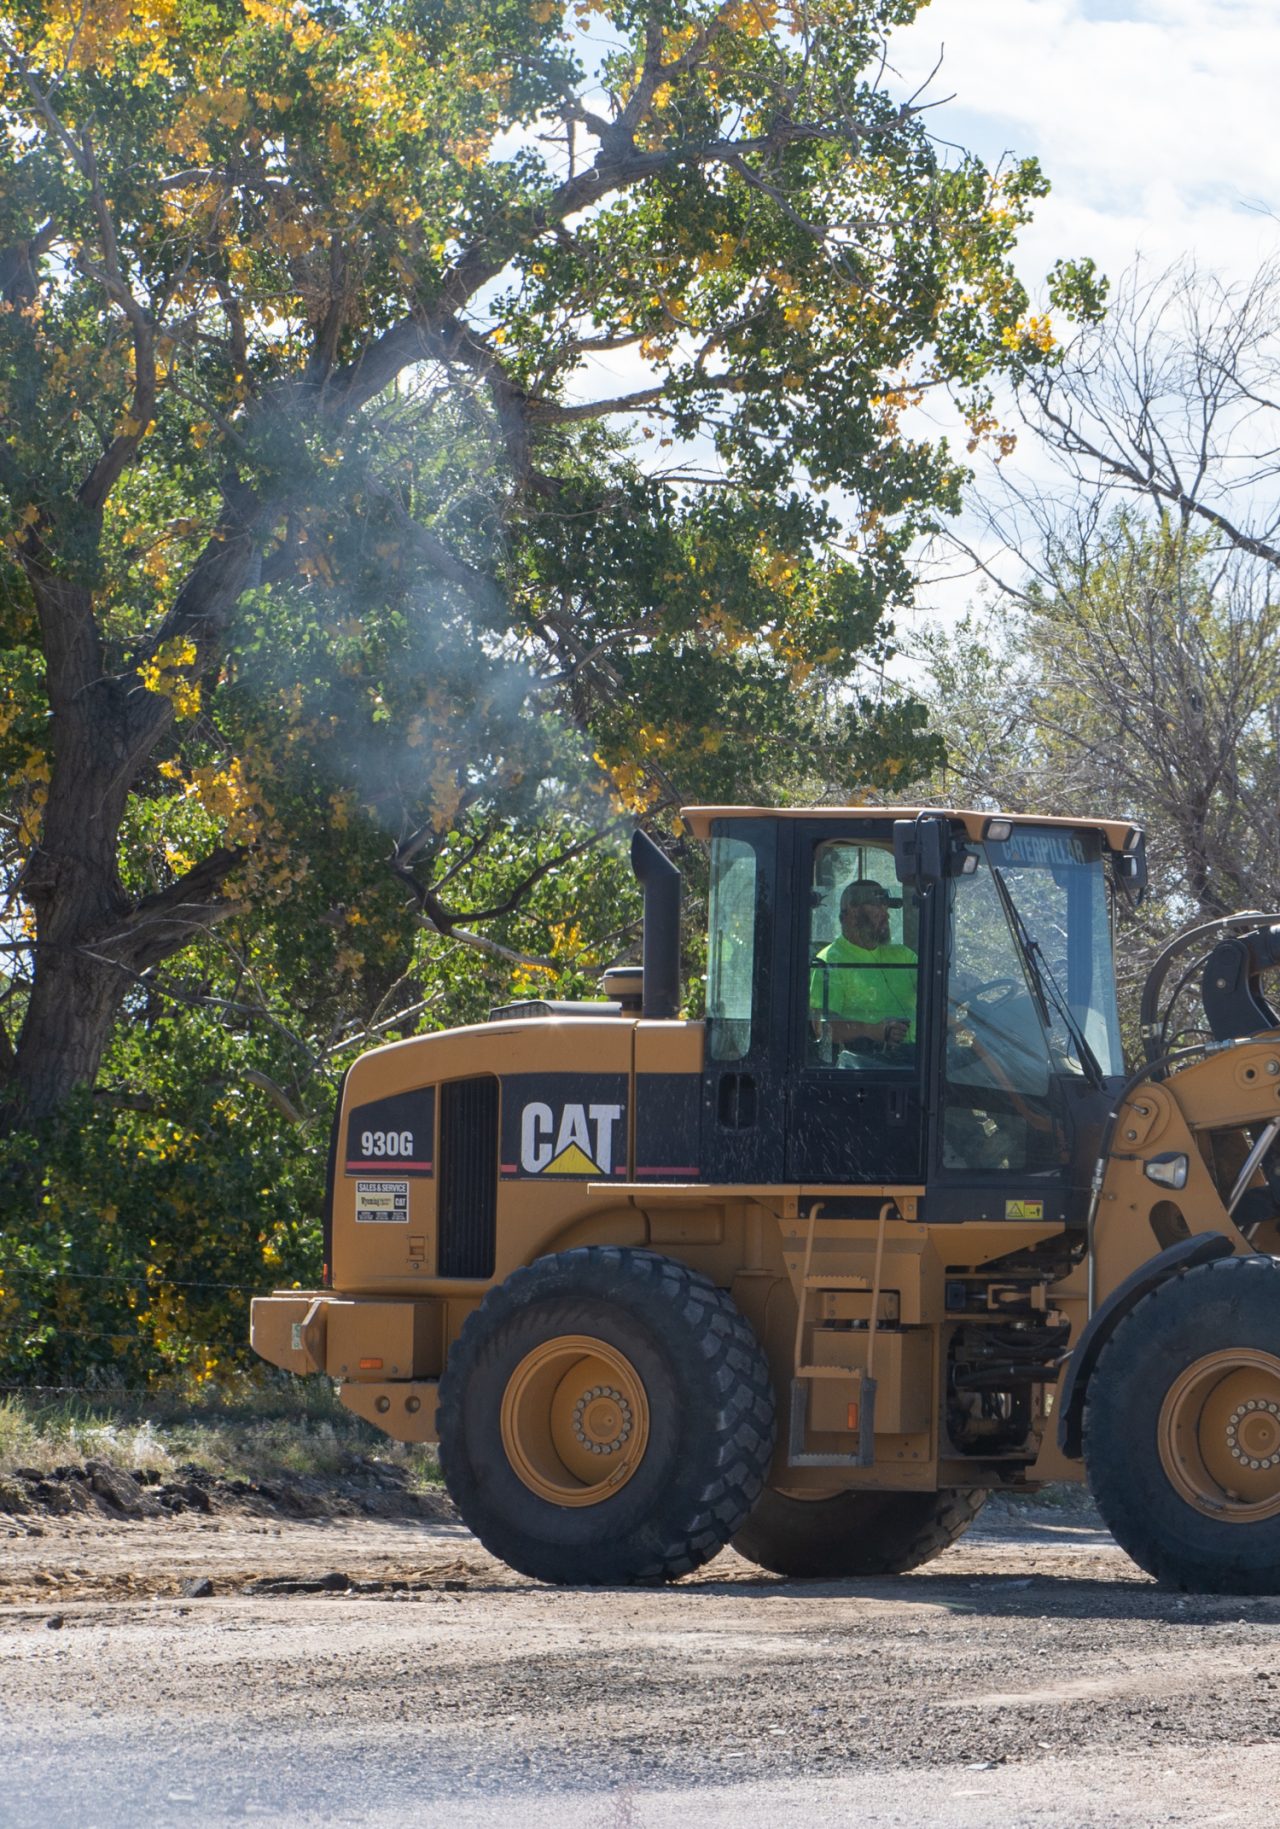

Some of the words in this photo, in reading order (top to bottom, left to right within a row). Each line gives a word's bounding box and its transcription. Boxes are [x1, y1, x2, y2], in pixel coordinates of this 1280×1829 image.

[1002, 835, 1086, 866] CATERPILLAR
[361, 1130, 413, 1156] 930G
[521, 1102, 621, 1175] CAT
[359, 1183, 376, 1192] SALES
[382, 1184, 406, 1192] SERVICE
[395, 1198, 406, 1206] CAT
